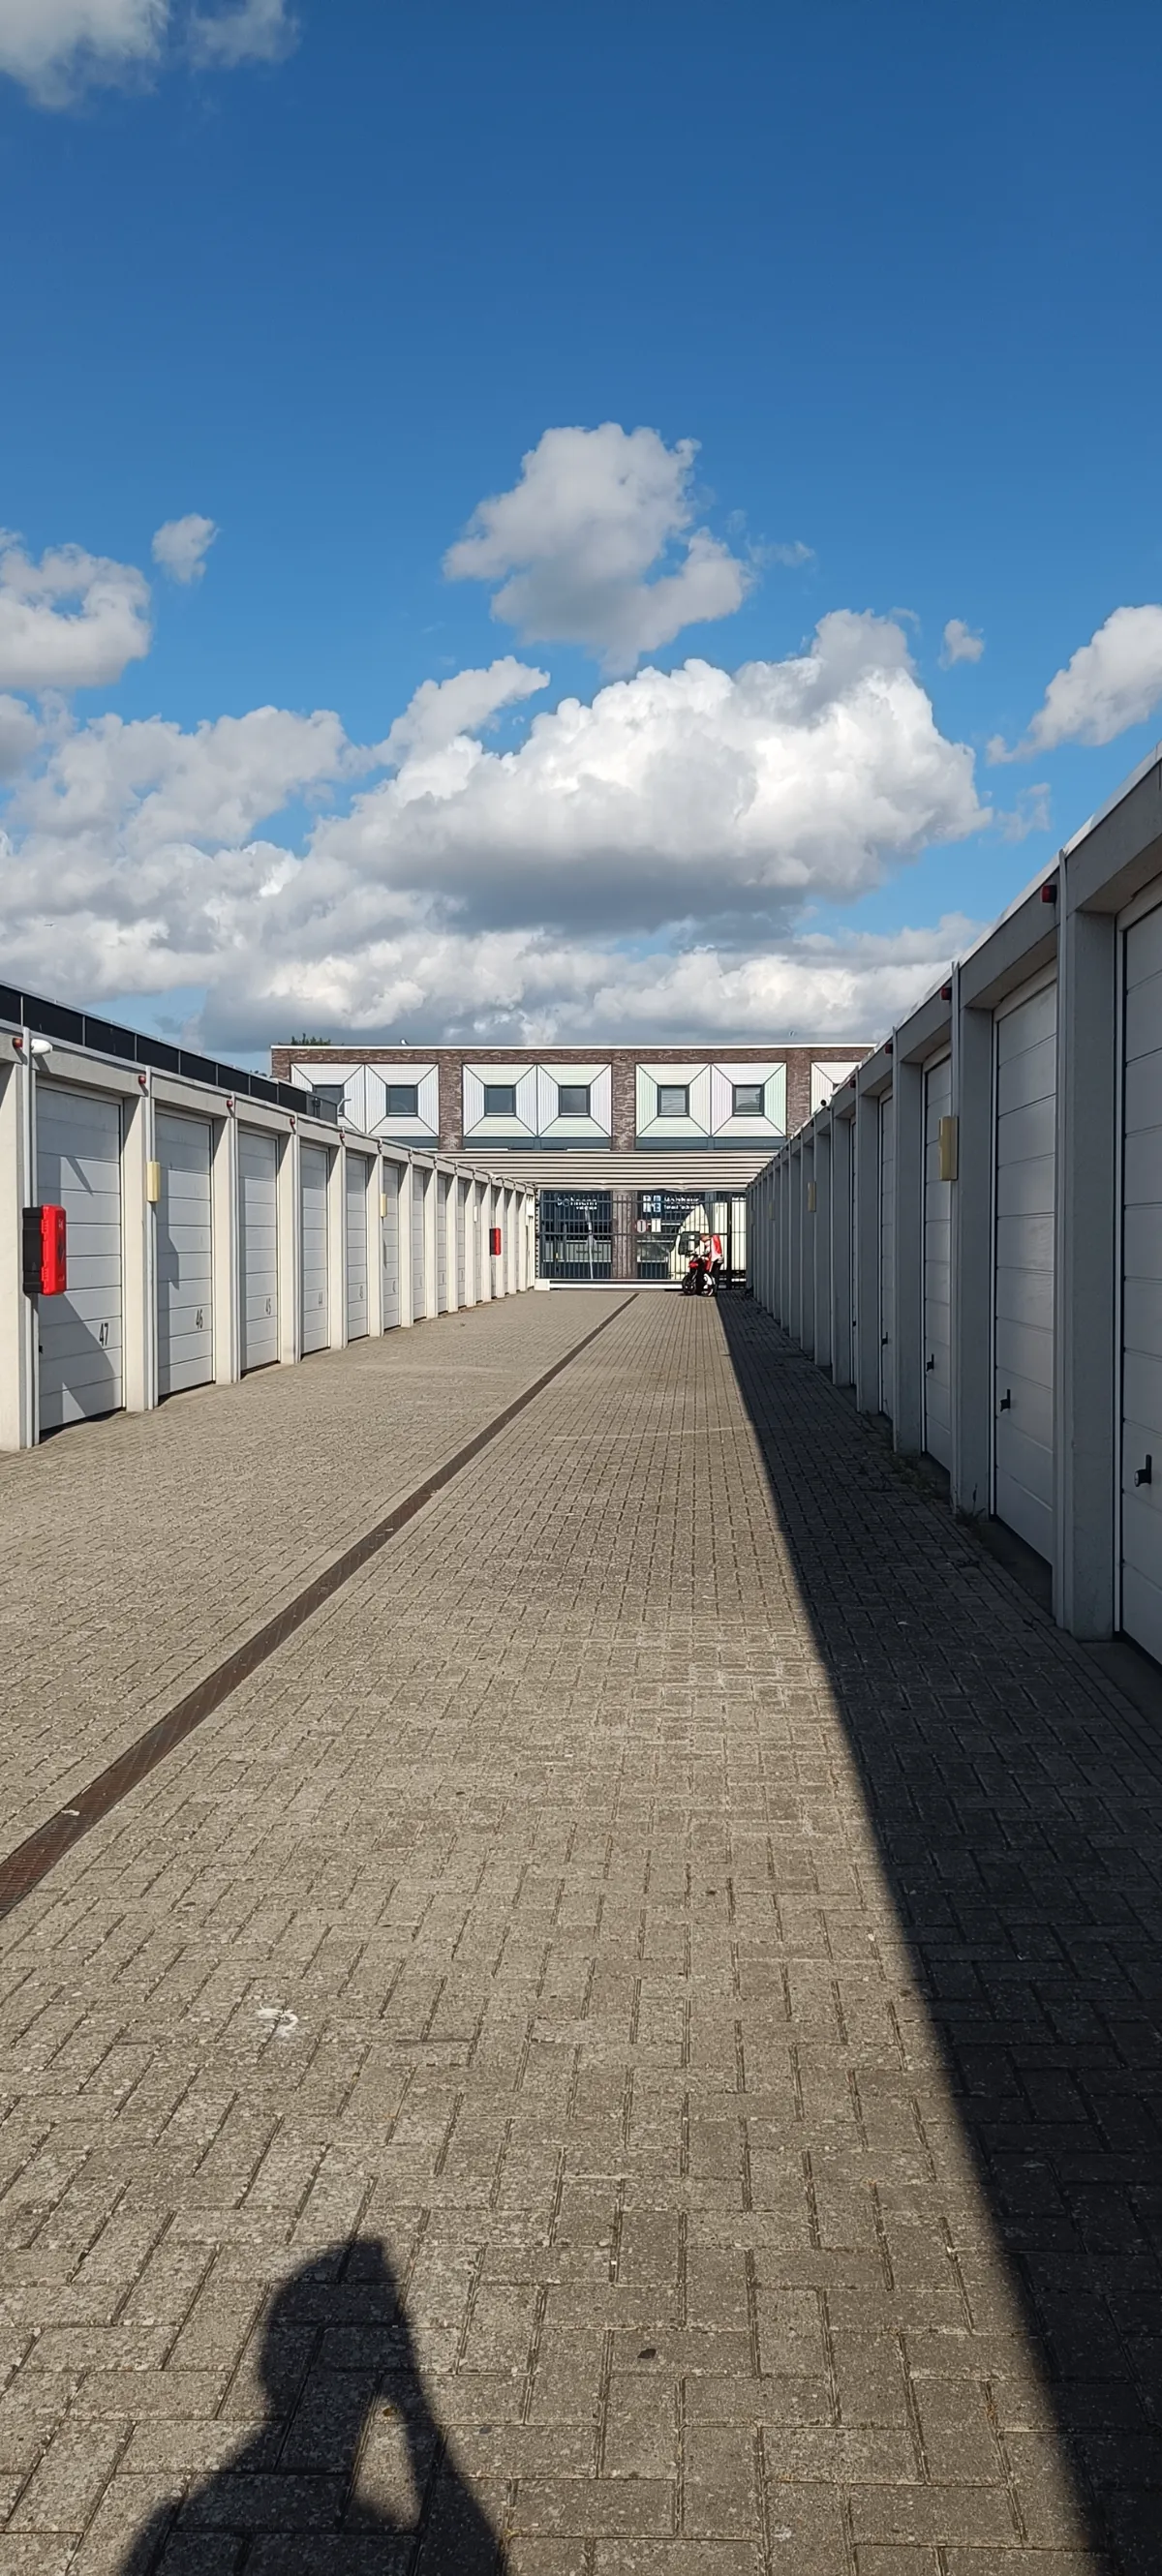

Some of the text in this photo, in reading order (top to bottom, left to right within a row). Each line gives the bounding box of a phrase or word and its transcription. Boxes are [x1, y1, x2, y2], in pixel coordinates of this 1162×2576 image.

[265, 1297, 271, 1316] 45
[196, 1308, 203, 1329] 46
[99, 1322, 108, 1347] 47
